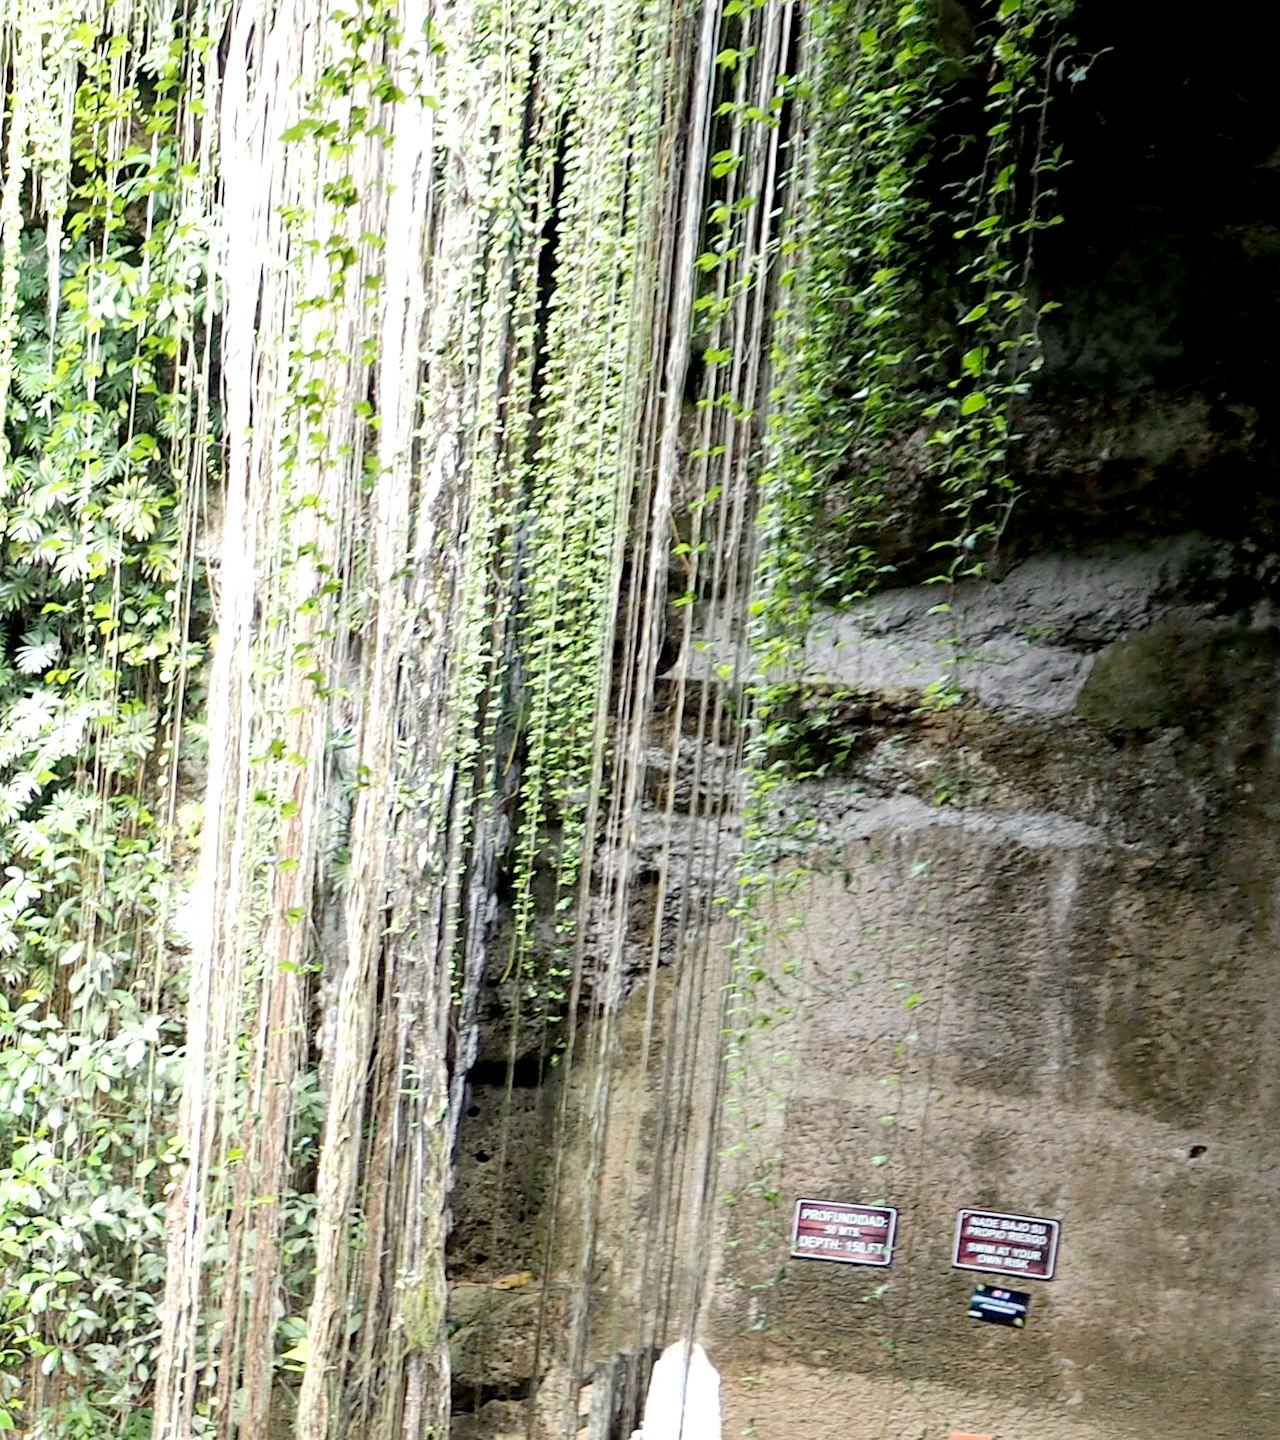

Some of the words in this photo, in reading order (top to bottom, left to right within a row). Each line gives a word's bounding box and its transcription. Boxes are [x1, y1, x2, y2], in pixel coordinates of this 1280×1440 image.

[801, 1208, 888, 1228] PROFUNDIDAD:
[969, 1216, 999, 1228] NADE
[1001, 1220, 1029, 1232] BAJO
[1030, 1224, 1047, 1234] SU
[966, 1226, 1006, 1239] PROPIO
[1007, 1231, 1047, 1245] RIESGO
[967, 1242, 996, 1254] SWIM
[996, 1246, 1011, 1256] AT
[1011, 1247, 1042, 1260] YOUR
[977, 1254, 1003, 1265] OWN
[1003, 1257, 1030, 1268] RISK
